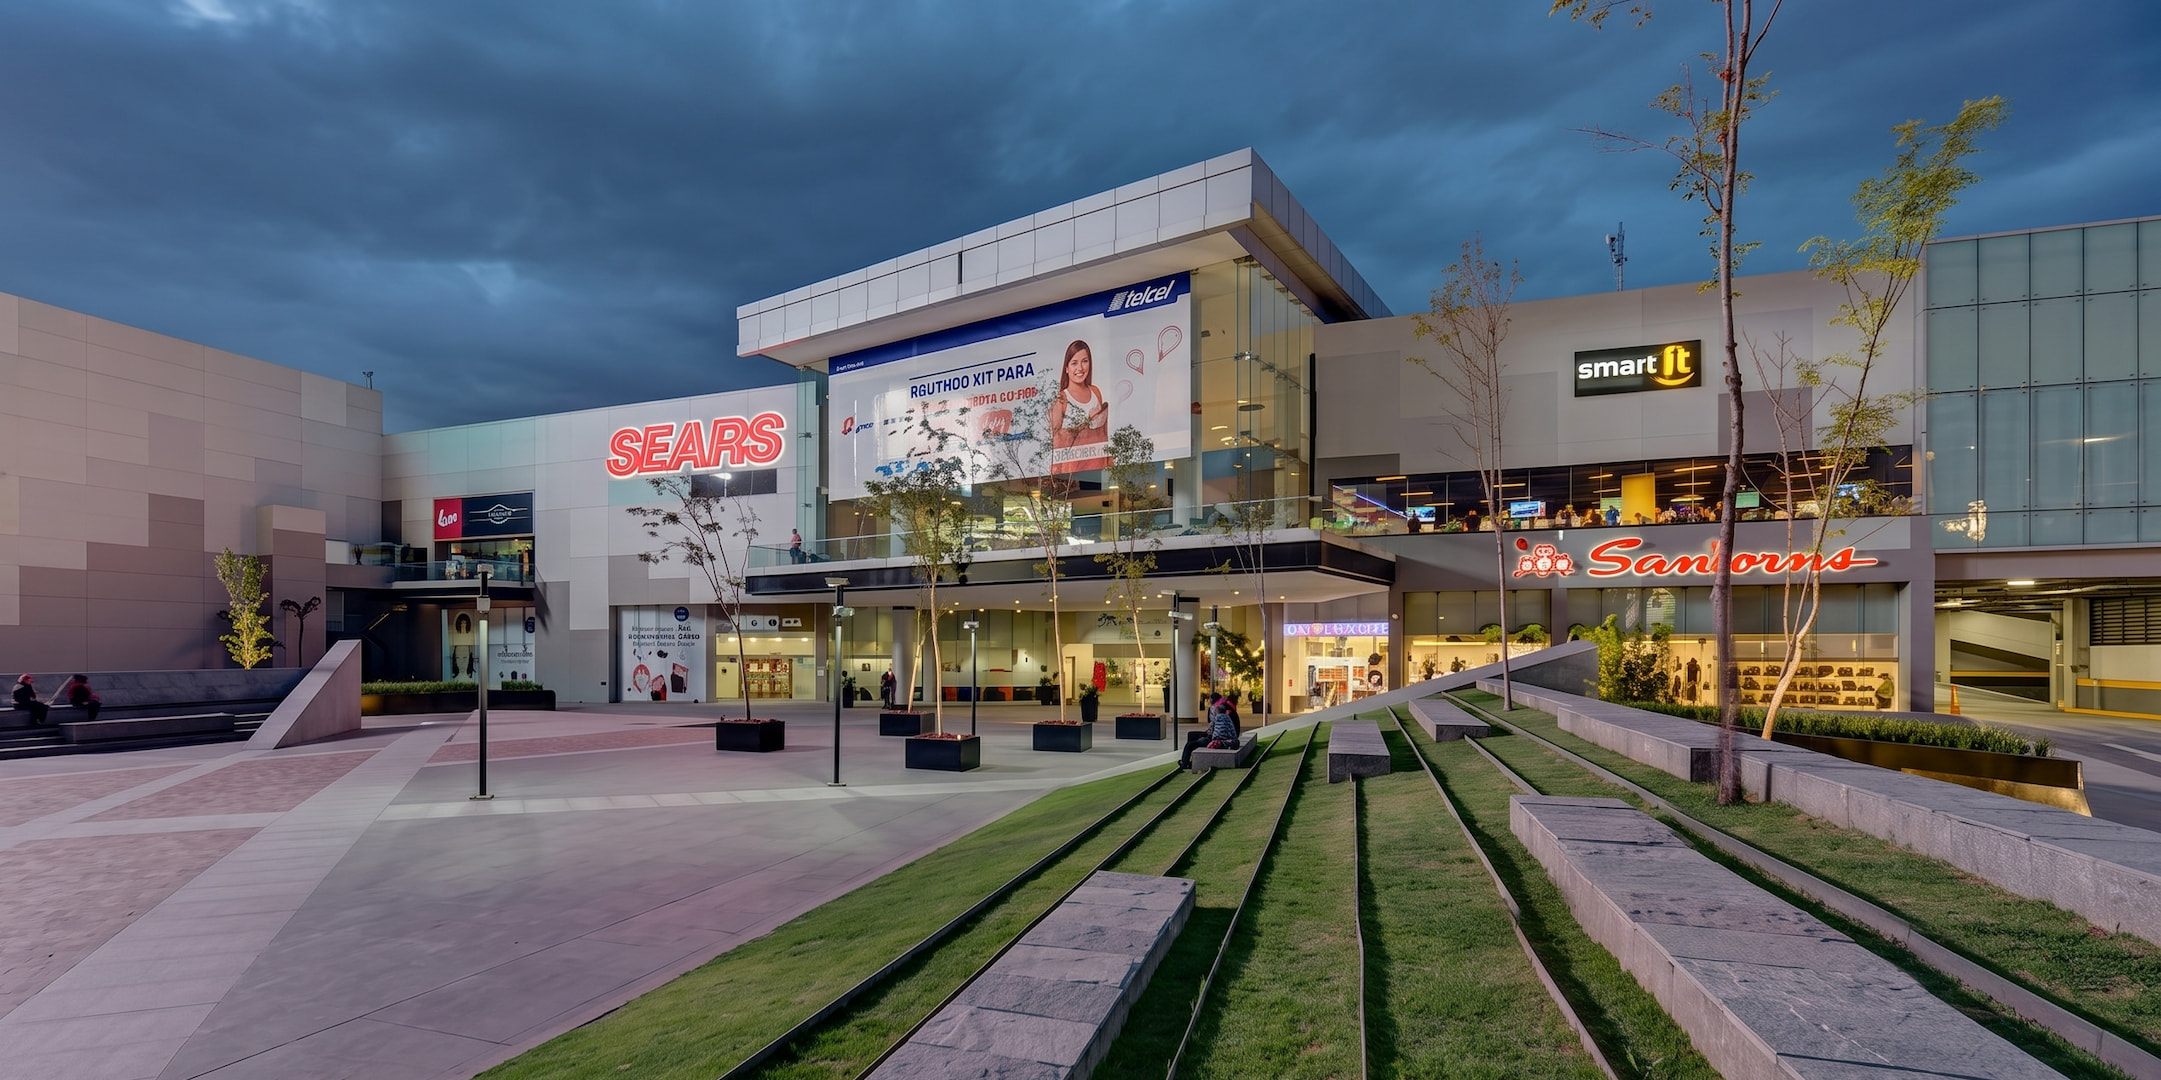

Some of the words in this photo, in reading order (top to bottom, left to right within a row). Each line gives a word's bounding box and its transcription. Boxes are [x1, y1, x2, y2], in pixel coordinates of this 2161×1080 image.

[1125, 280, 1176, 309] telcel
[973, 369, 994, 387] XIT
[997, 362, 1035, 382] PARA
[1578, 355, 1657, 379] smart
[605, 411, 786, 478] SEARS
